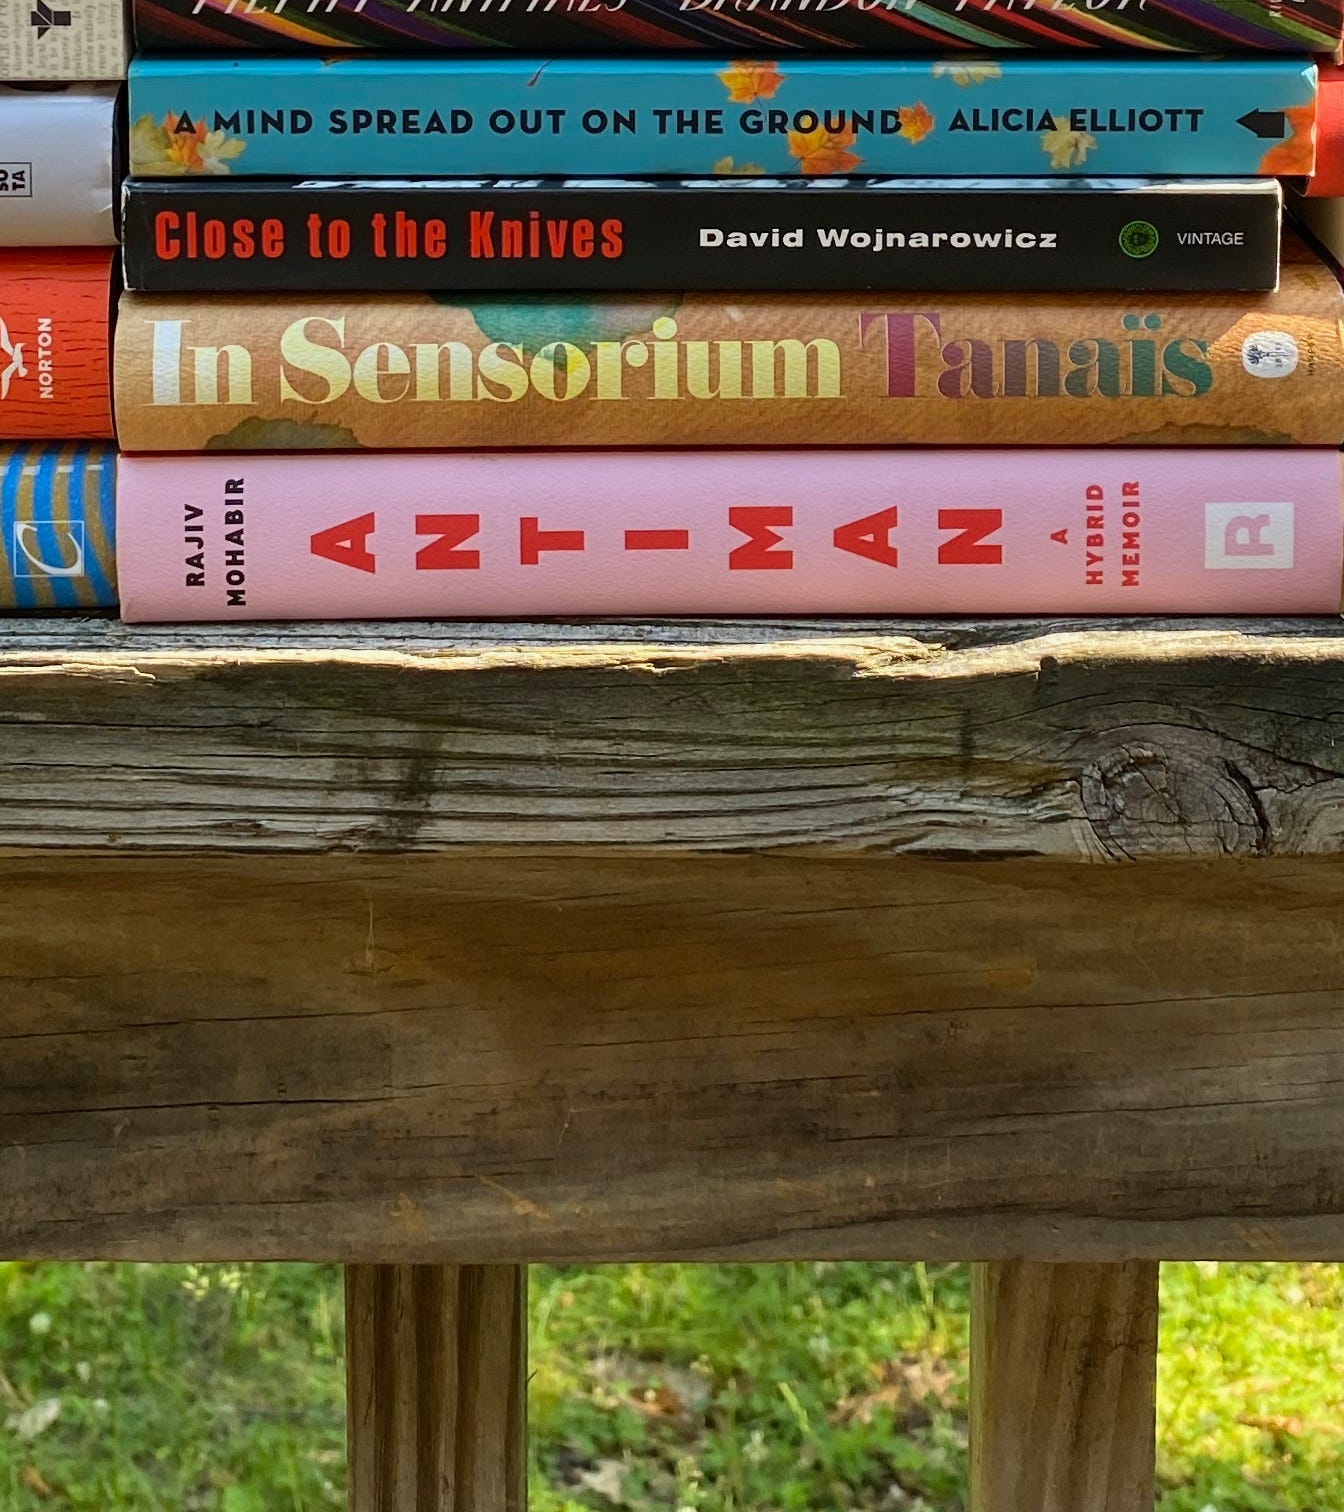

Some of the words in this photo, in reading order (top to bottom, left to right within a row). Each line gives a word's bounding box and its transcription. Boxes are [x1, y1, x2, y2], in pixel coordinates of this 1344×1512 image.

[173, 111, 198, 134] A
[212, 110, 314, 134] MIND
[328, 110, 474, 134] SPREAD
[489, 109, 567, 134] OUT
[582, 110, 638, 134] ON
[653, 110, 724, 134] THE
[739, 109, 902, 134] GROUND
[948, 108, 1057, 132] ALICIA
[1070, 109, 1205, 132] ELLIOTT
[155, 210, 285, 260] Close
[308, 211, 351, 260] to
[372, 210, 447, 259] the
[468, 210, 624, 259] Knives
[698, 227, 804, 249] David
[817, 227, 1057, 254] Wojnarowicz
[1177, 231, 1244, 246] VINTAGE
[39, 317, 54, 400] NORTON
[144, 318, 258, 407] In
[279, 315, 848, 405] Sensorium
[857, 312, 1214, 400] Tanaïs
[184, 503, 206, 587] RAJIV
[224, 477, 247, 607] MOHABIR
[1085, 483, 1104, 585] HYBRID
[1121, 480, 1140, 588] MEMOIR
